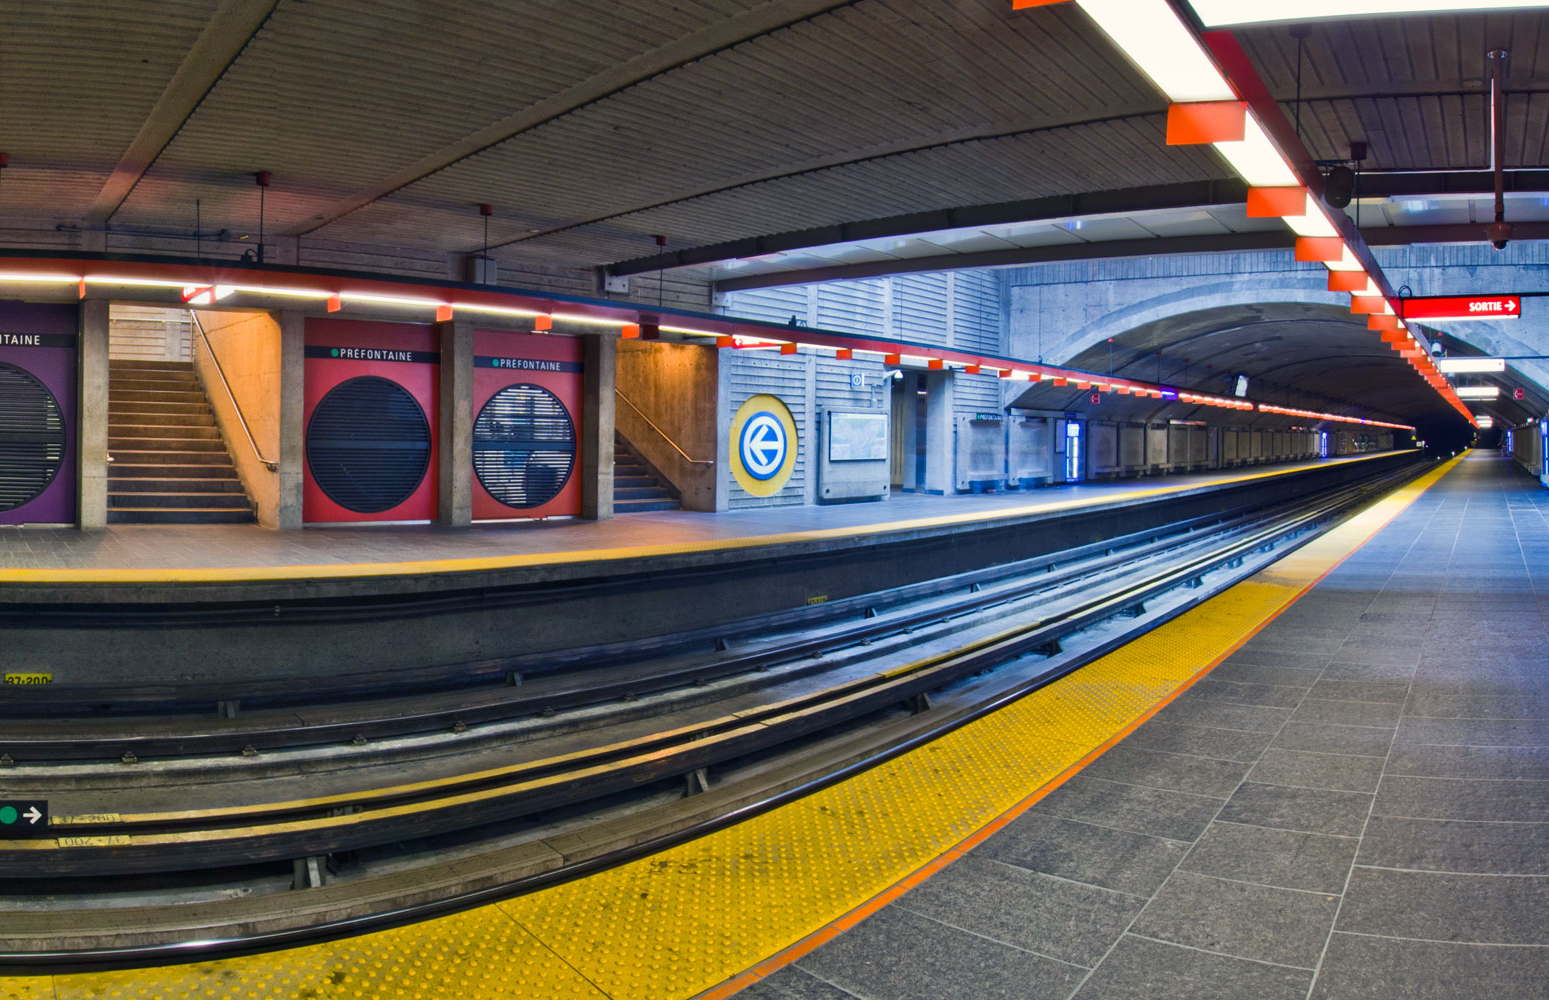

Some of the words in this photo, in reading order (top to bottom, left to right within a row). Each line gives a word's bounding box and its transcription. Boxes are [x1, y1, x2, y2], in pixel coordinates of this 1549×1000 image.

[1469, 301, 1502, 312] SORTIE
[340, 348, 412, 361] PRÉFONTAINE
[500, 358, 561, 371] PRÉFONTAINE
